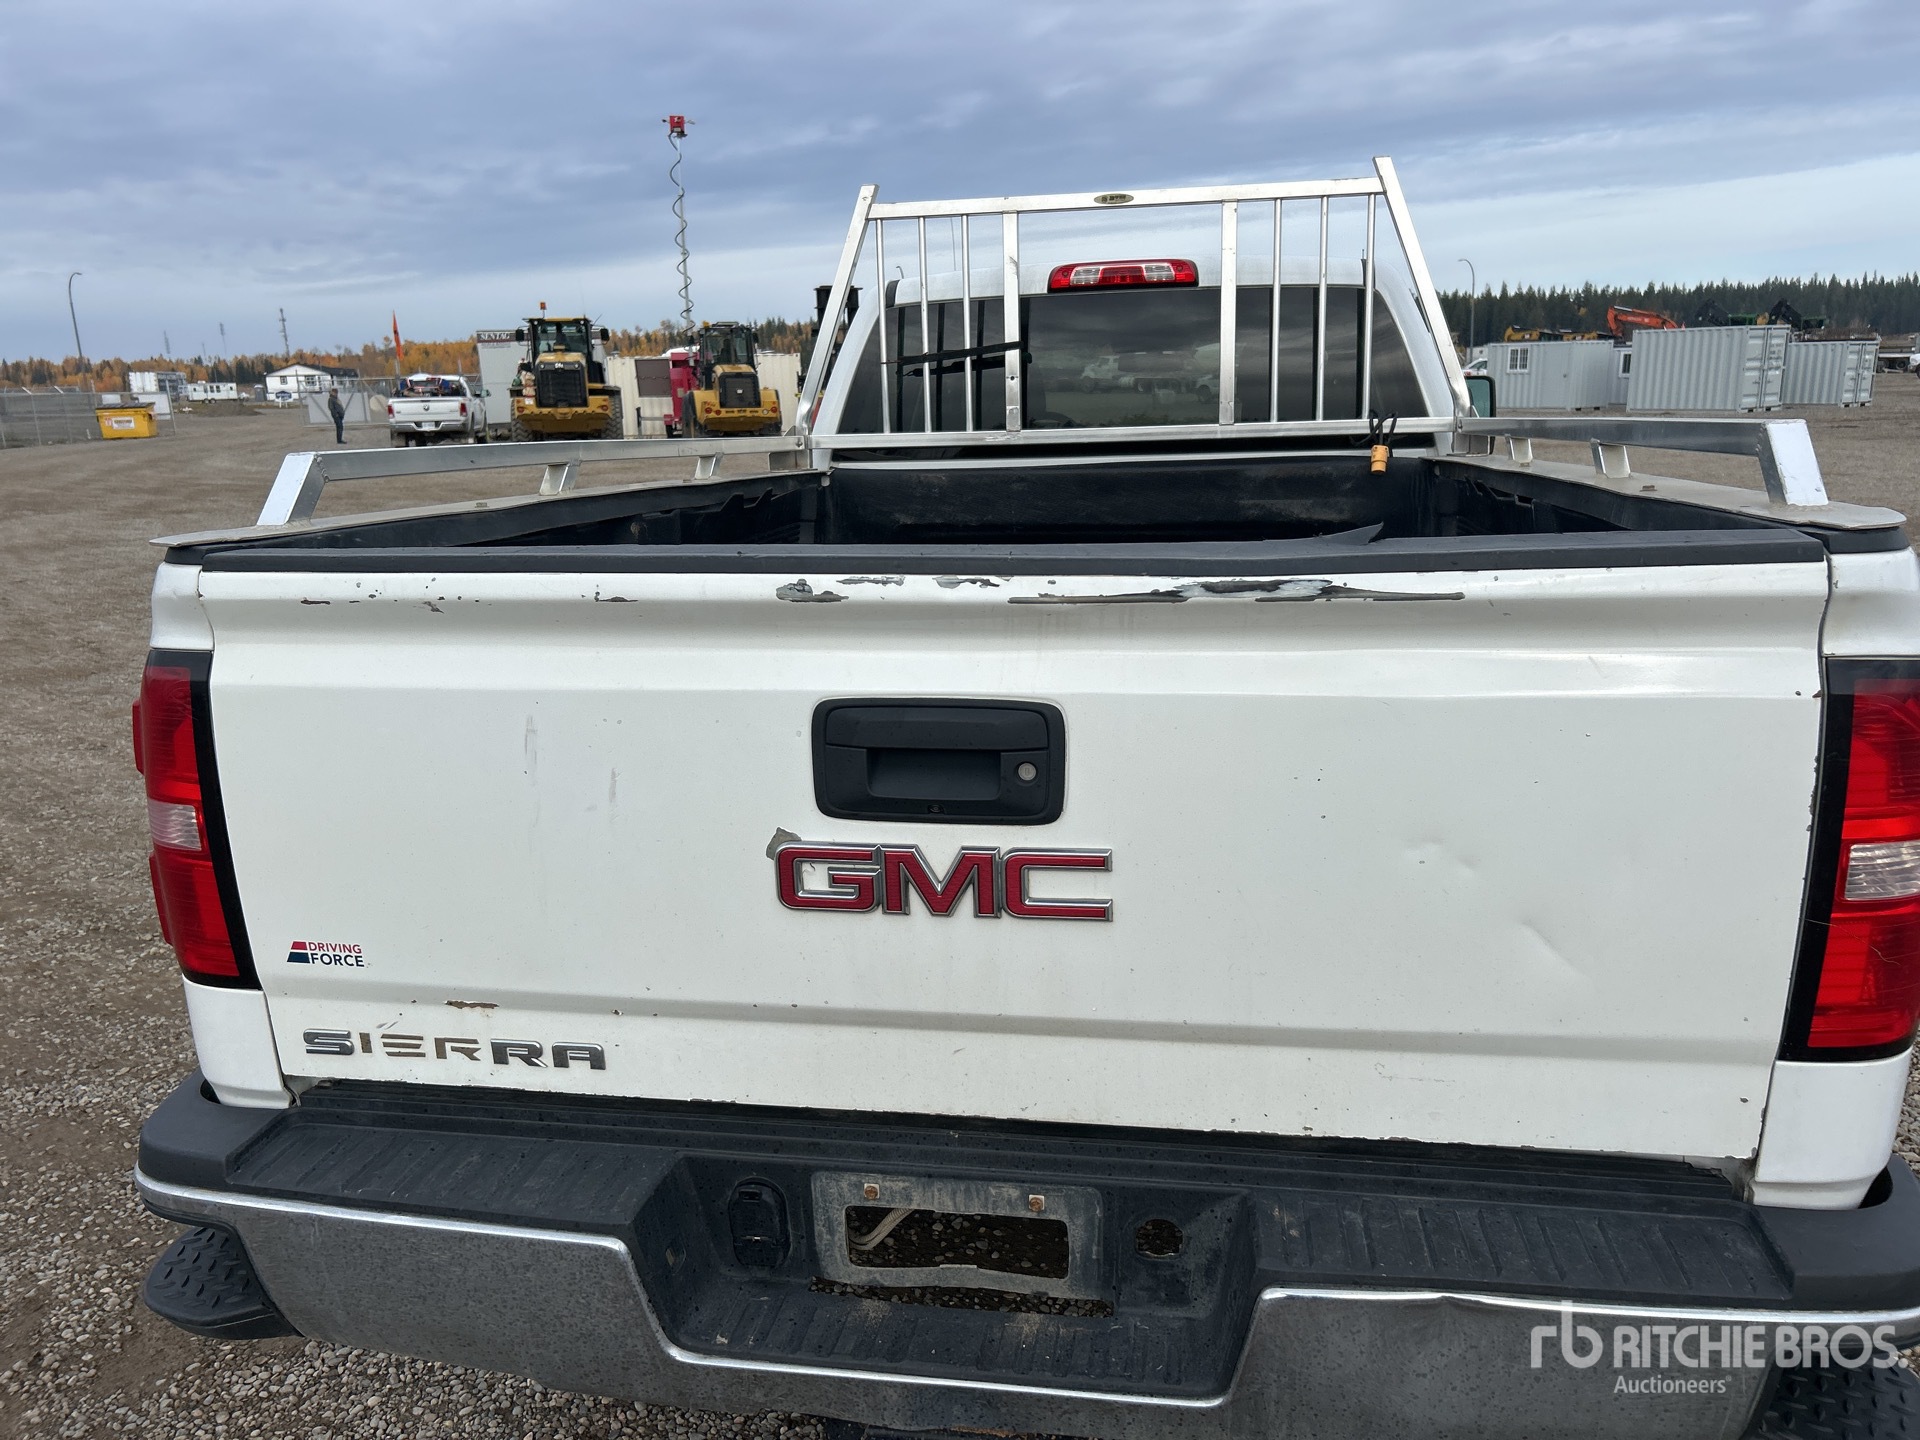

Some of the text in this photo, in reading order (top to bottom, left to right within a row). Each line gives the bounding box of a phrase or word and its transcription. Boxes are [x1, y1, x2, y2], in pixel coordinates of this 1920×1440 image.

[774, 840, 1113, 922] GMC
[307, 941, 362, 954] DRIVING
[310, 953, 365, 967] FORCE
[303, 1028, 607, 1071] SIERRA
